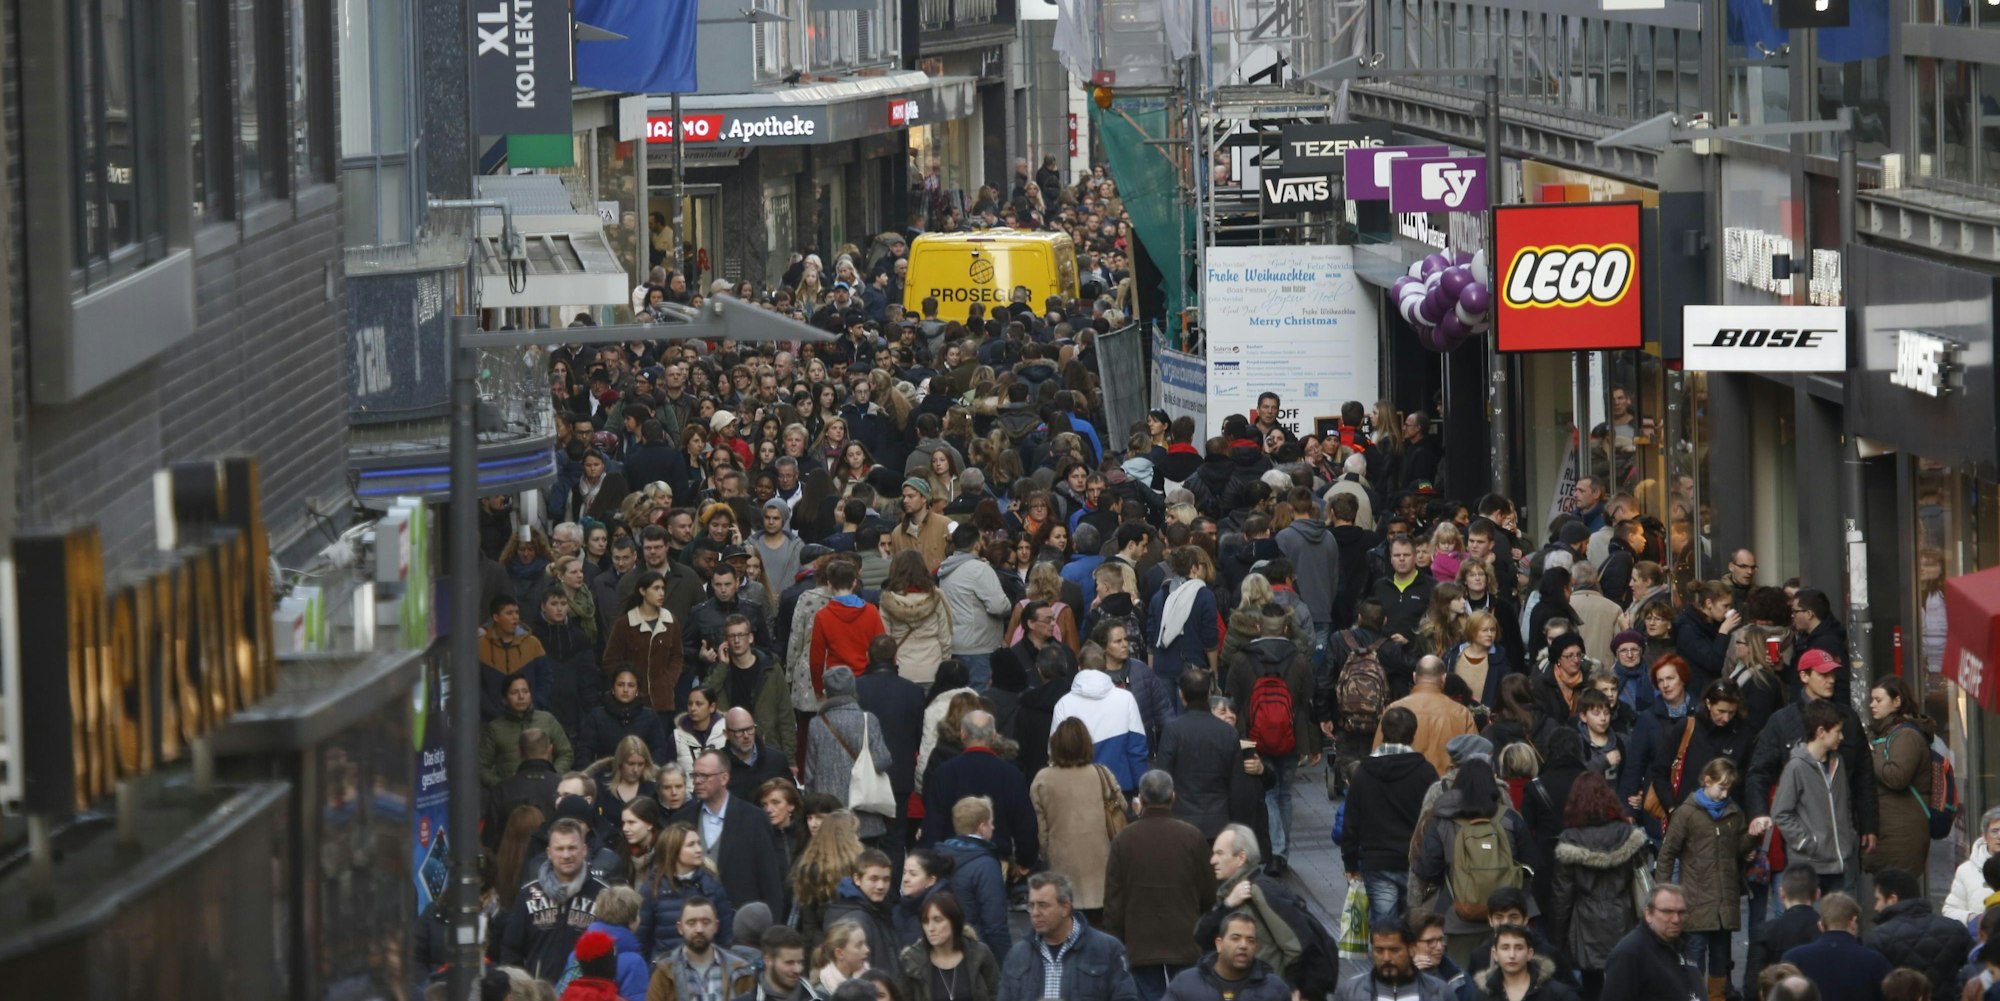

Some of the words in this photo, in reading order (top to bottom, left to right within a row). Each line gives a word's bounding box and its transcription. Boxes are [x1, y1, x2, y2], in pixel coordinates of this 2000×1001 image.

[478, 2, 508, 56] XL
[728, 114, 815, 142] Apotheke
[1265, 176, 1329, 203] VANS
[1208, 268, 1239, 283] Frohe
[1245, 267, 1316, 282] Weihnachten
[1507, 247, 1631, 305] LEGO
[1249, 316, 1281, 328] Merry
[1284, 315, 1338, 326] Christmas
[1693, 329, 1838, 348] BOSE
